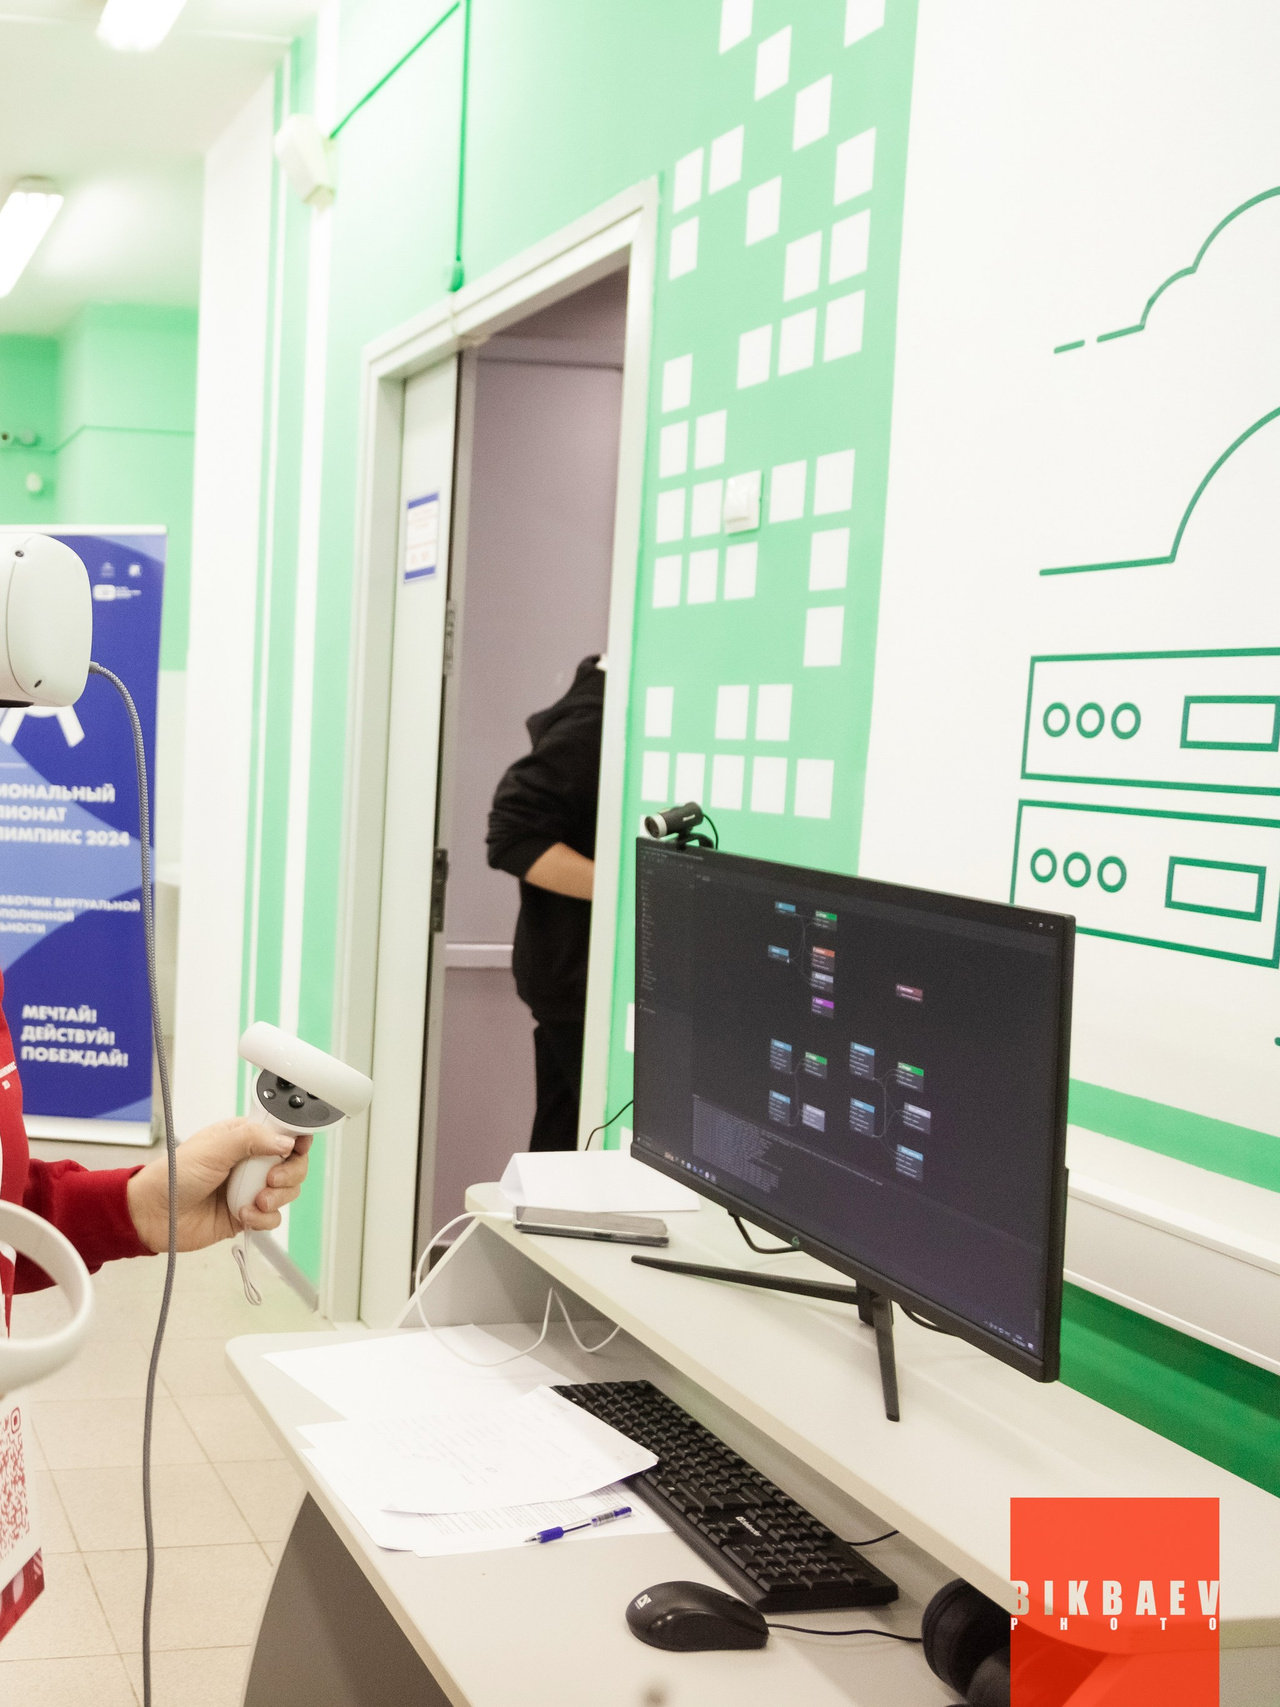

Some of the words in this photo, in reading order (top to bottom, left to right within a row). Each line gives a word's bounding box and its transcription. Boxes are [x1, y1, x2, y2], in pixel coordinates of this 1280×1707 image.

[85, 830, 130, 847] 2024
[53, 896, 141, 912] ВИРТУАЛЬНОЙ
[21, 1003, 98, 1024] МЕЧТАЙ!
[20, 1023, 116, 1046] ДЕЙСТВУЙ!
[20, 1046, 129, 1068] ПОБЕЖДАЙ!
